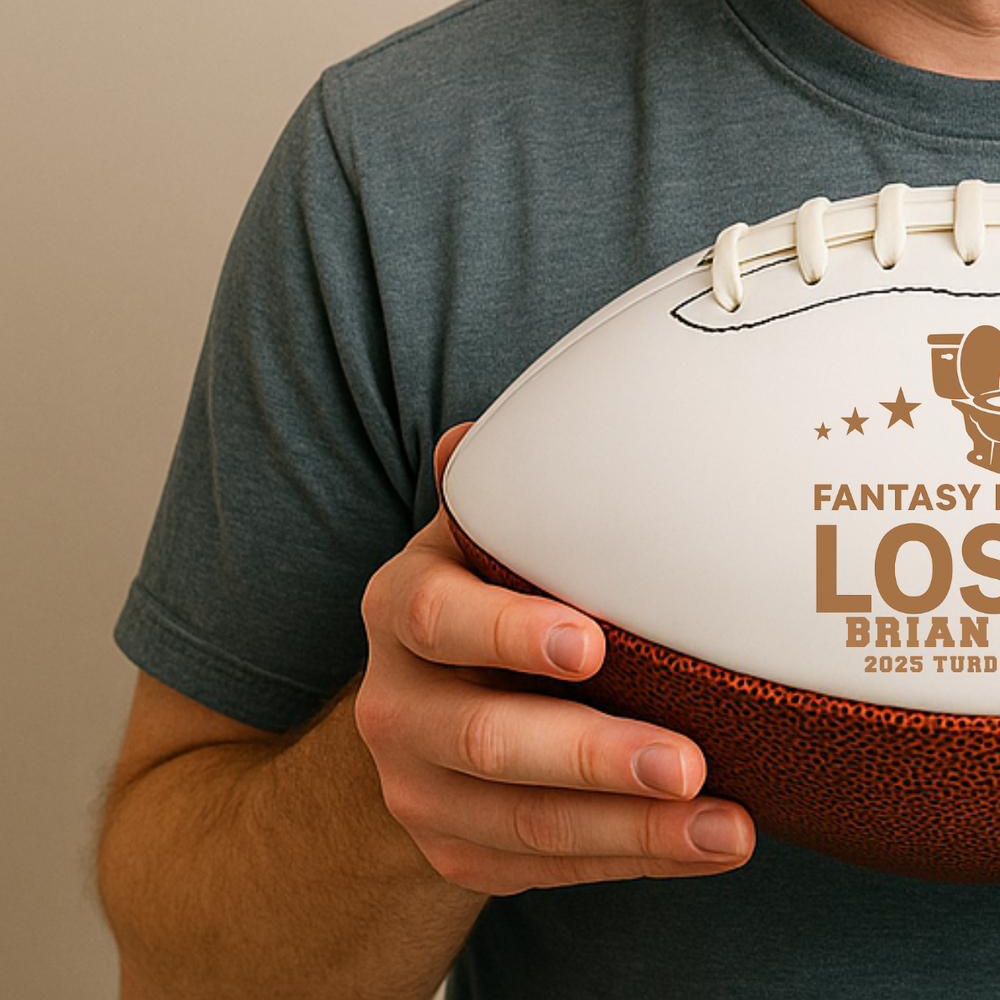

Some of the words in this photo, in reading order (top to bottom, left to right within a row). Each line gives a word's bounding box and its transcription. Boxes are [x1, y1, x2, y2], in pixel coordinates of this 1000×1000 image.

[814, 484, 981, 511] FANTASY
[846, 617, 988, 647] BRIAN
[865, 656, 923, 672] 2025
[933, 656, 997, 672] TURD
